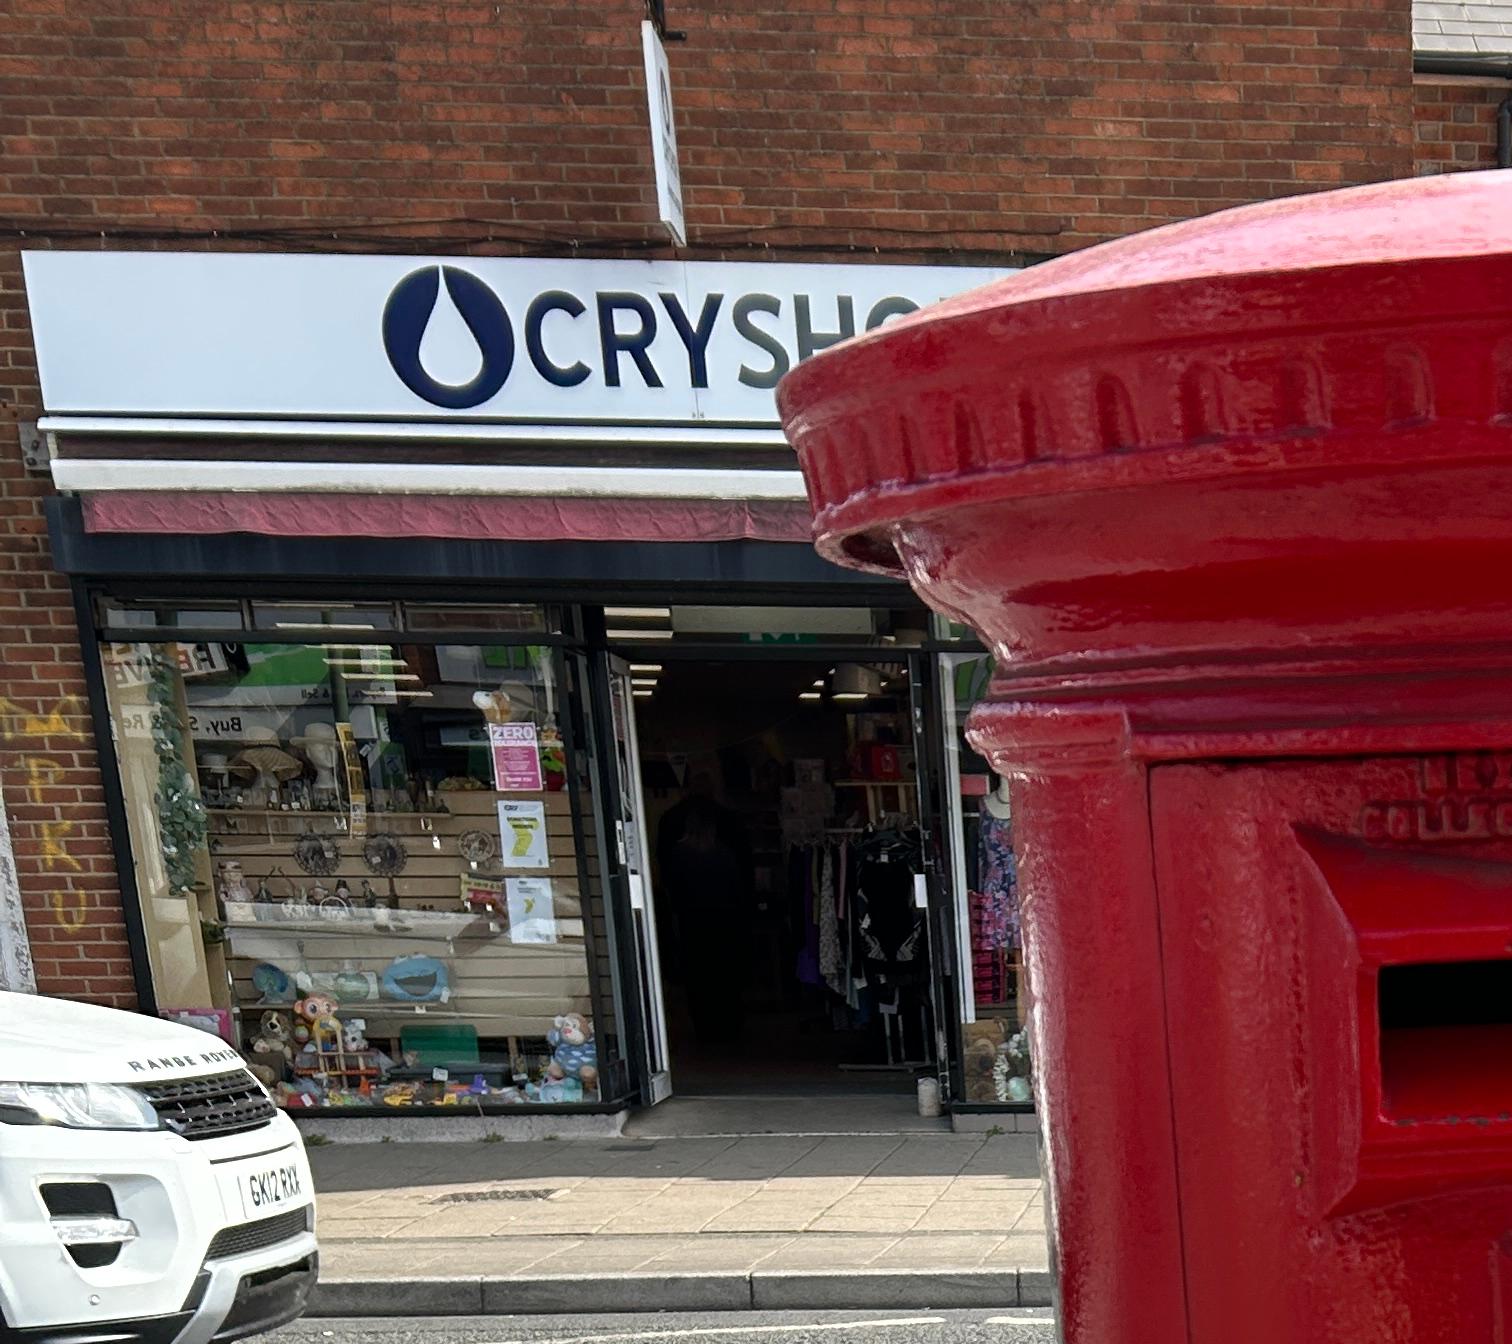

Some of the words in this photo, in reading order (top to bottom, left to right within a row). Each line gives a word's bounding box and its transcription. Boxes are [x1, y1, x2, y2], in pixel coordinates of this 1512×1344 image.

[525, 289, 942, 389] CRYSH
[492, 725, 534, 739] ZERO
[127, 1056, 197, 1072] RANGE
[200, 1049, 240, 1064] ROVER
[250, 1170, 281, 1206] GK12
